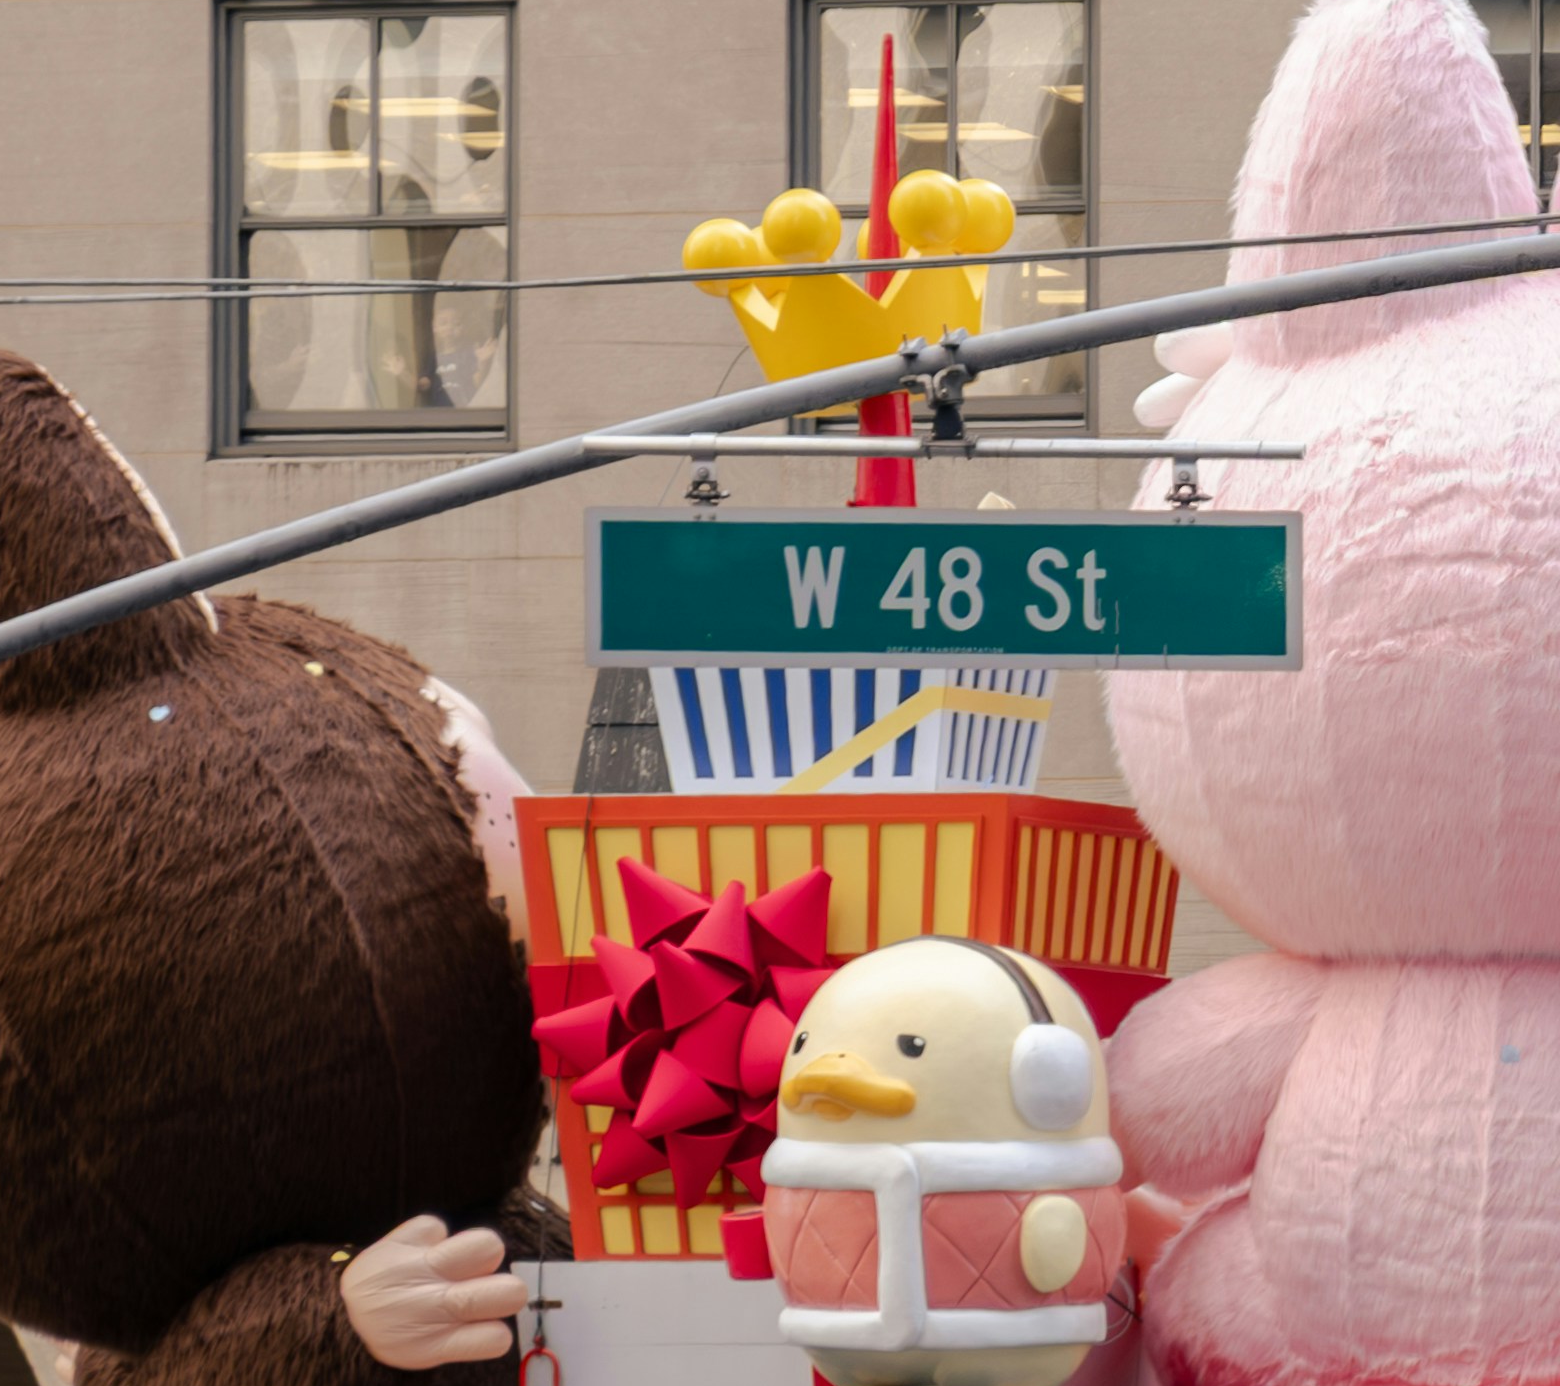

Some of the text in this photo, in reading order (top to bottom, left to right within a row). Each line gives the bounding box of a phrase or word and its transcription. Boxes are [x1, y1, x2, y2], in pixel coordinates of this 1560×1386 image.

[783, 545, 1107, 632] W 48 St
